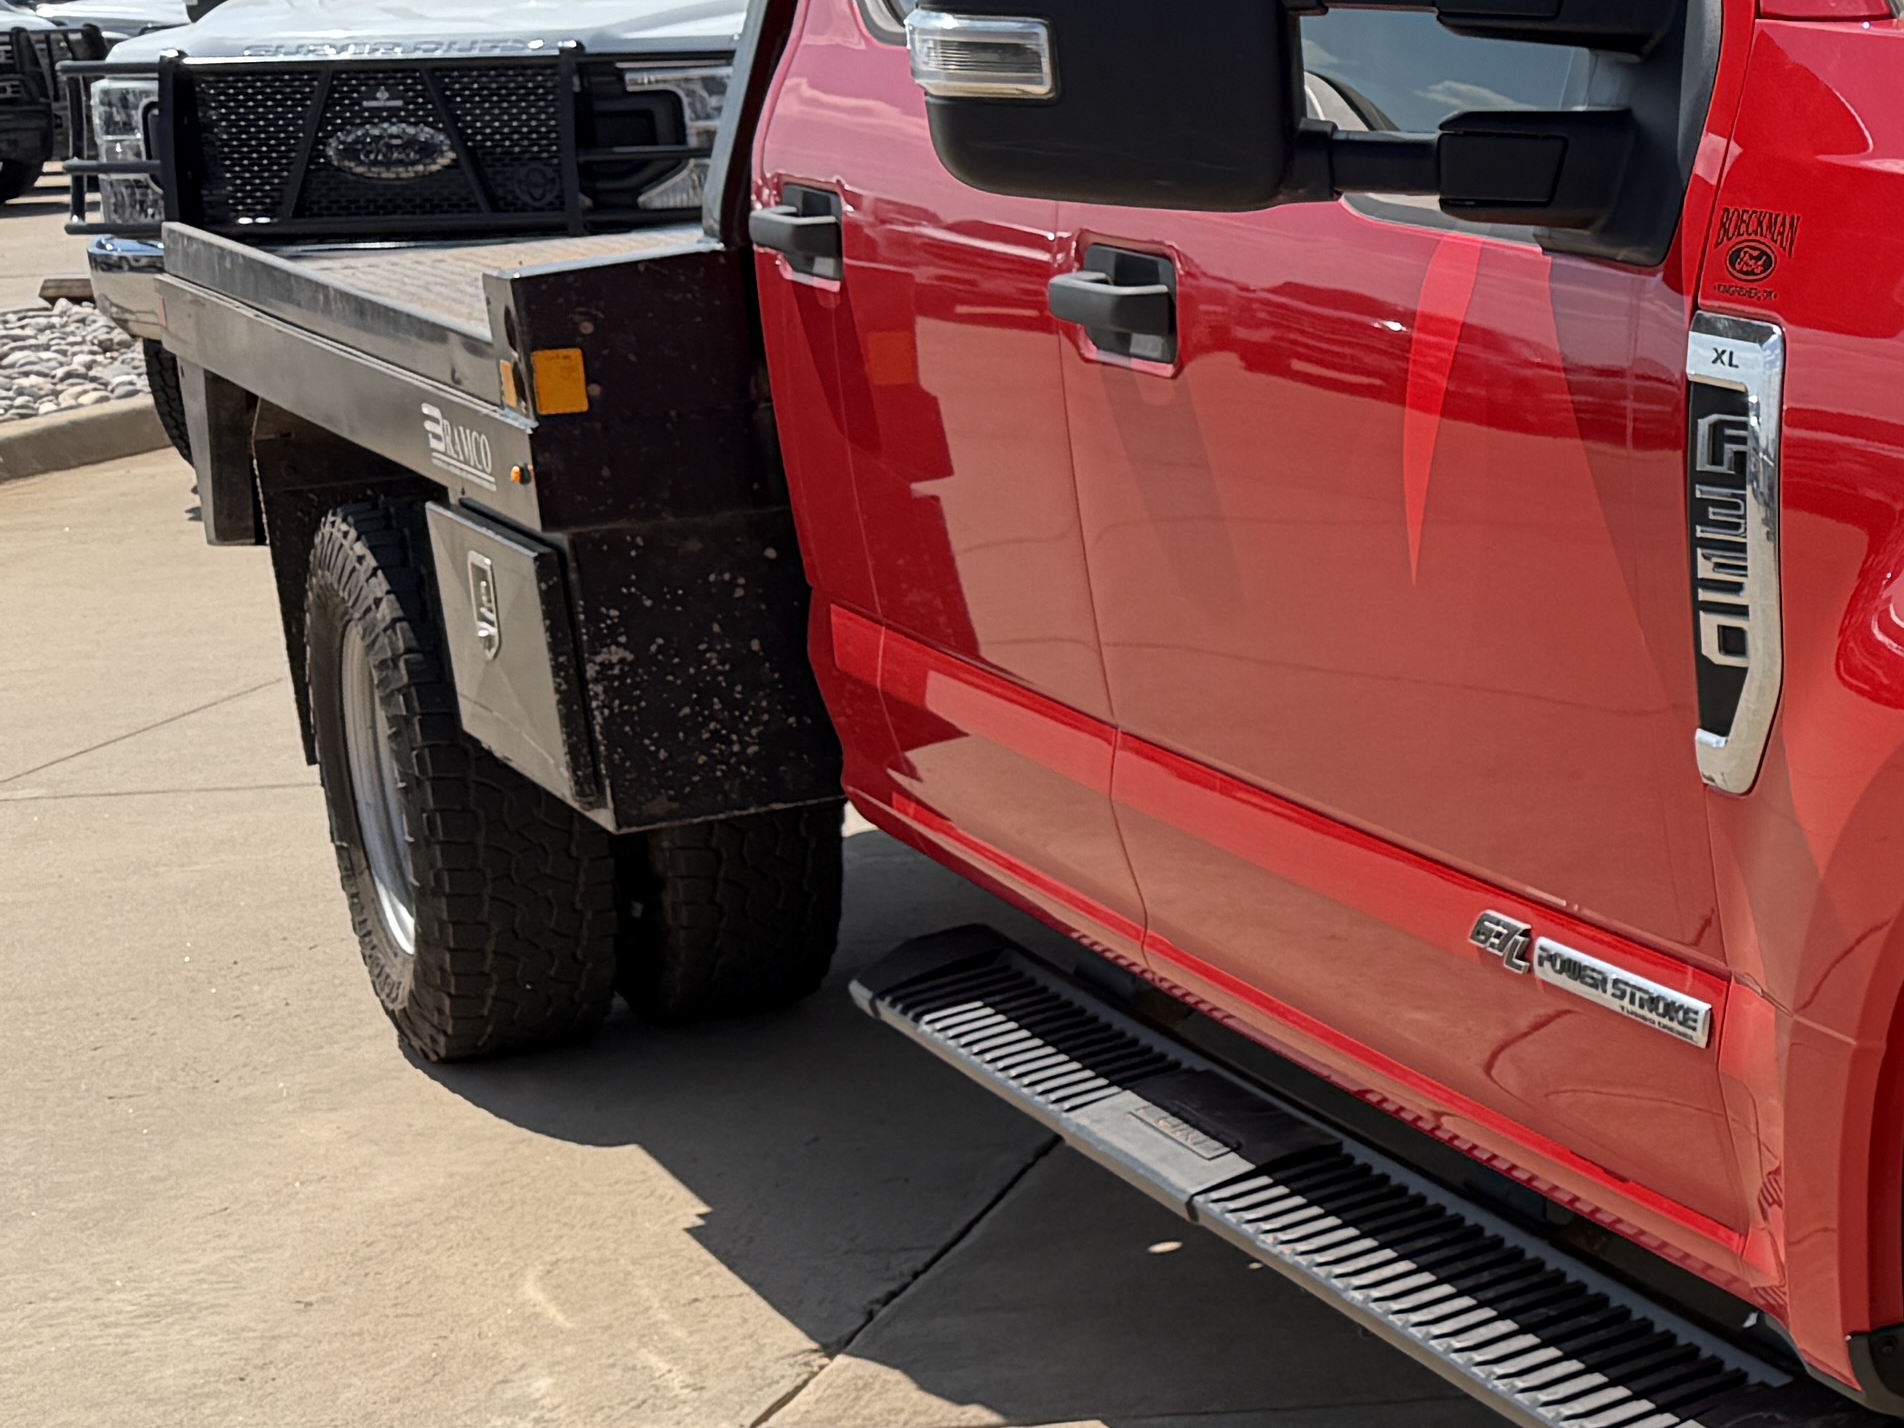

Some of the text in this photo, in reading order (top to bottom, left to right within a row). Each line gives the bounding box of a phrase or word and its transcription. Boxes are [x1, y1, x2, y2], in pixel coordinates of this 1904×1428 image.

[1714, 206, 1801, 260] BOECKMAN
[1711, 347, 1739, 369] XL
[421, 402, 492, 474] BRAMCO
[1537, 945, 1608, 994] POWER
[1611, 976, 1700, 1033] STROKE
